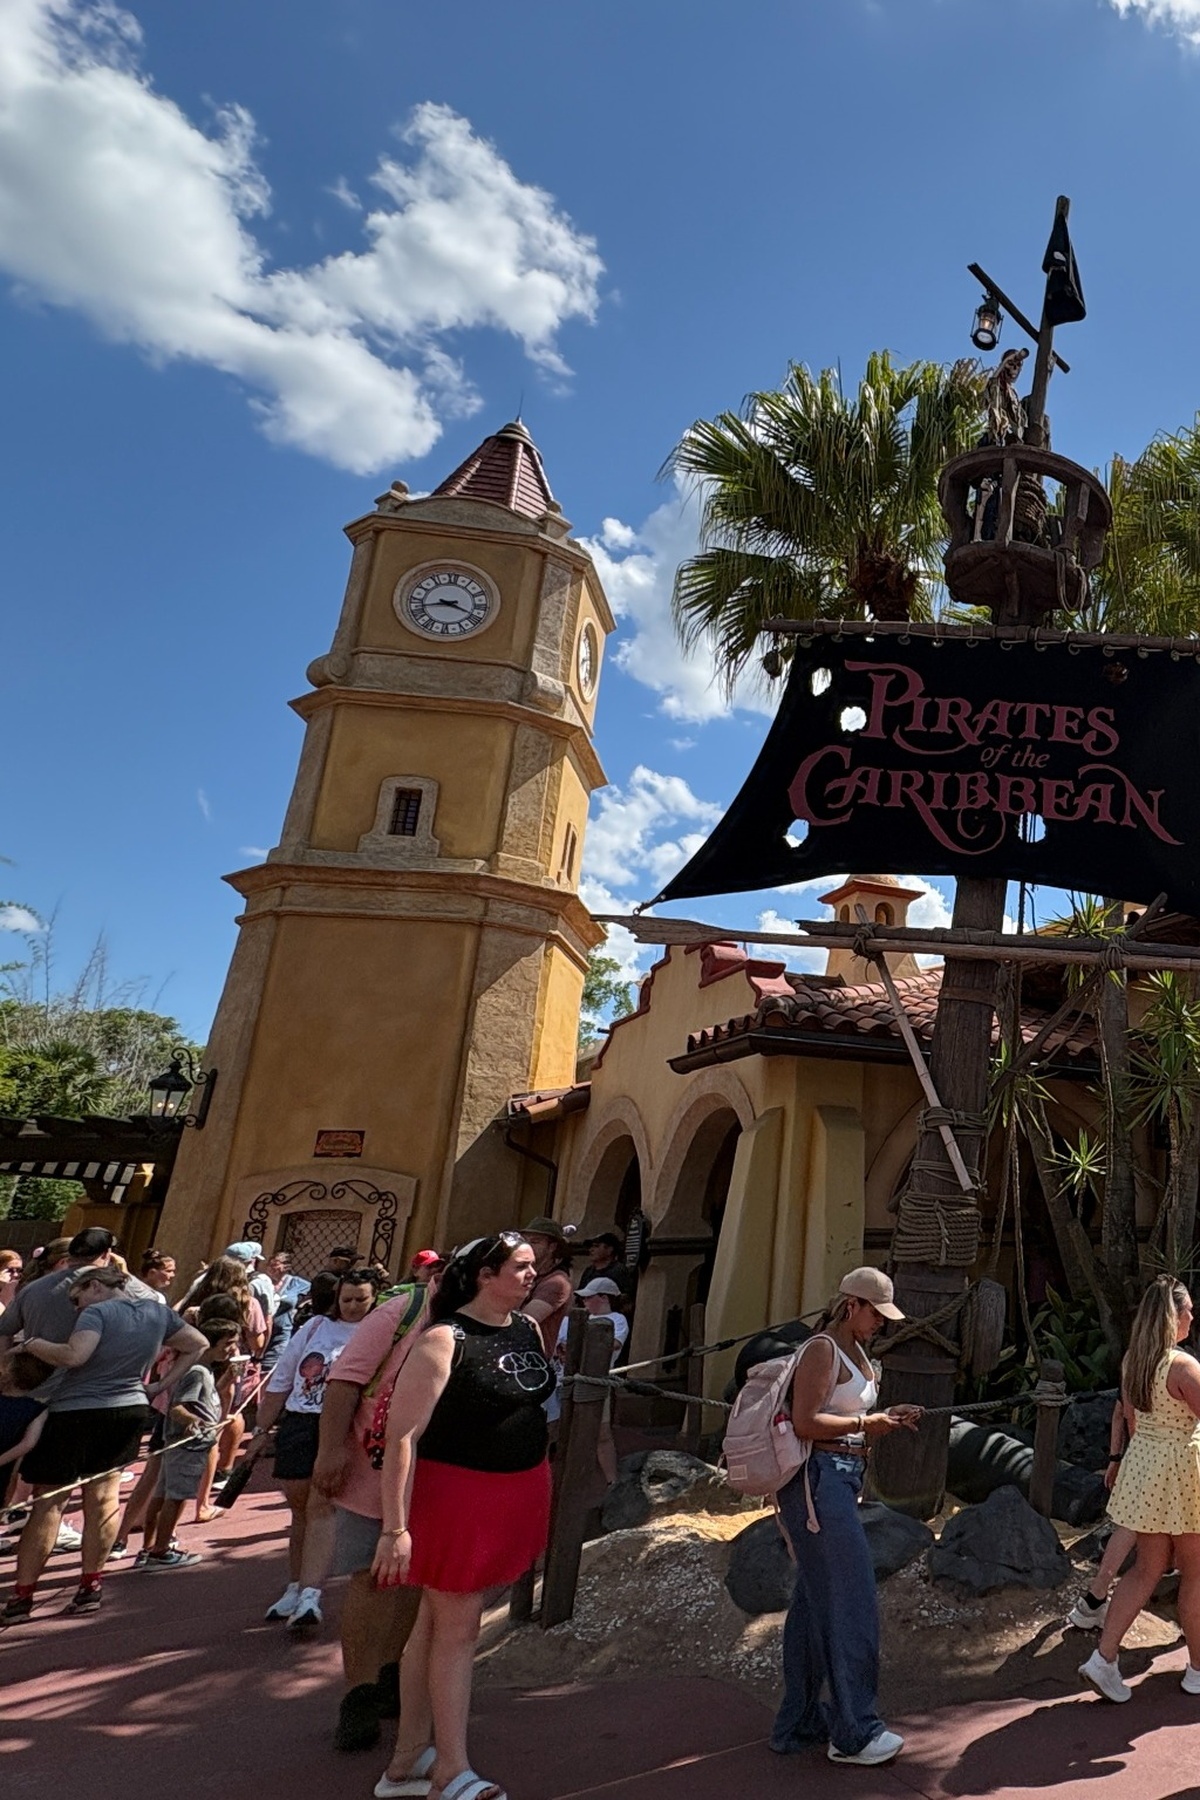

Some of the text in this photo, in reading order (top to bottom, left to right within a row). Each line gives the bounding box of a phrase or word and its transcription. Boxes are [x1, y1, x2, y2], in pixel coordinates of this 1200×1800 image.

[844, 659, 1120, 756] PIRATES
[980, 744, 1050, 768] of the
[788, 745, 1185, 856] CARIBBEAN
